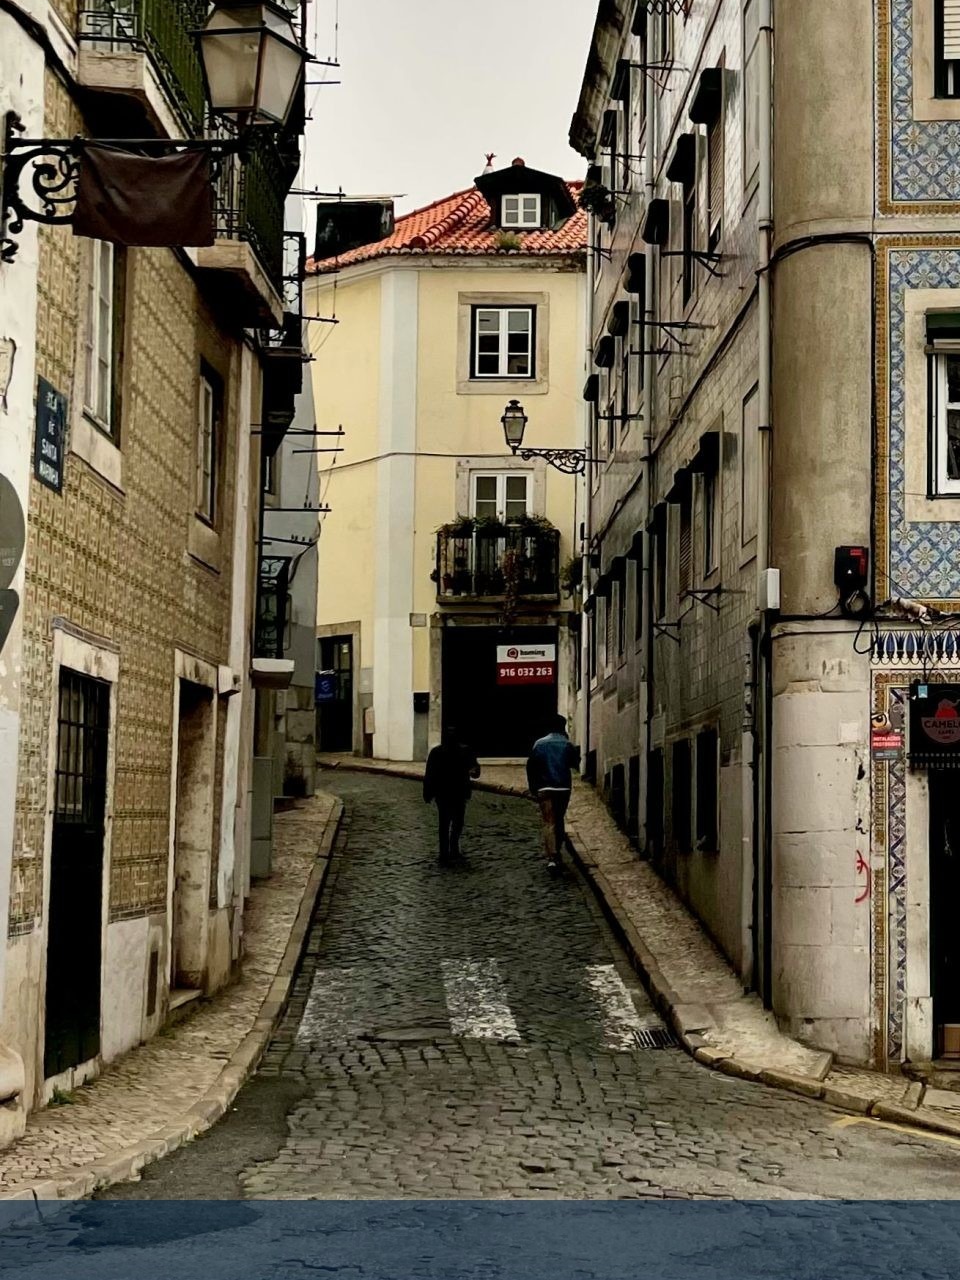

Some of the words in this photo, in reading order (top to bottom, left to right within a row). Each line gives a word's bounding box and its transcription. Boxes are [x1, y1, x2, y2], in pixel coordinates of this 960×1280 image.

[500, 668, 516, 677] 916
[517, 668, 534, 677] 032
[536, 667, 553, 676] 263
